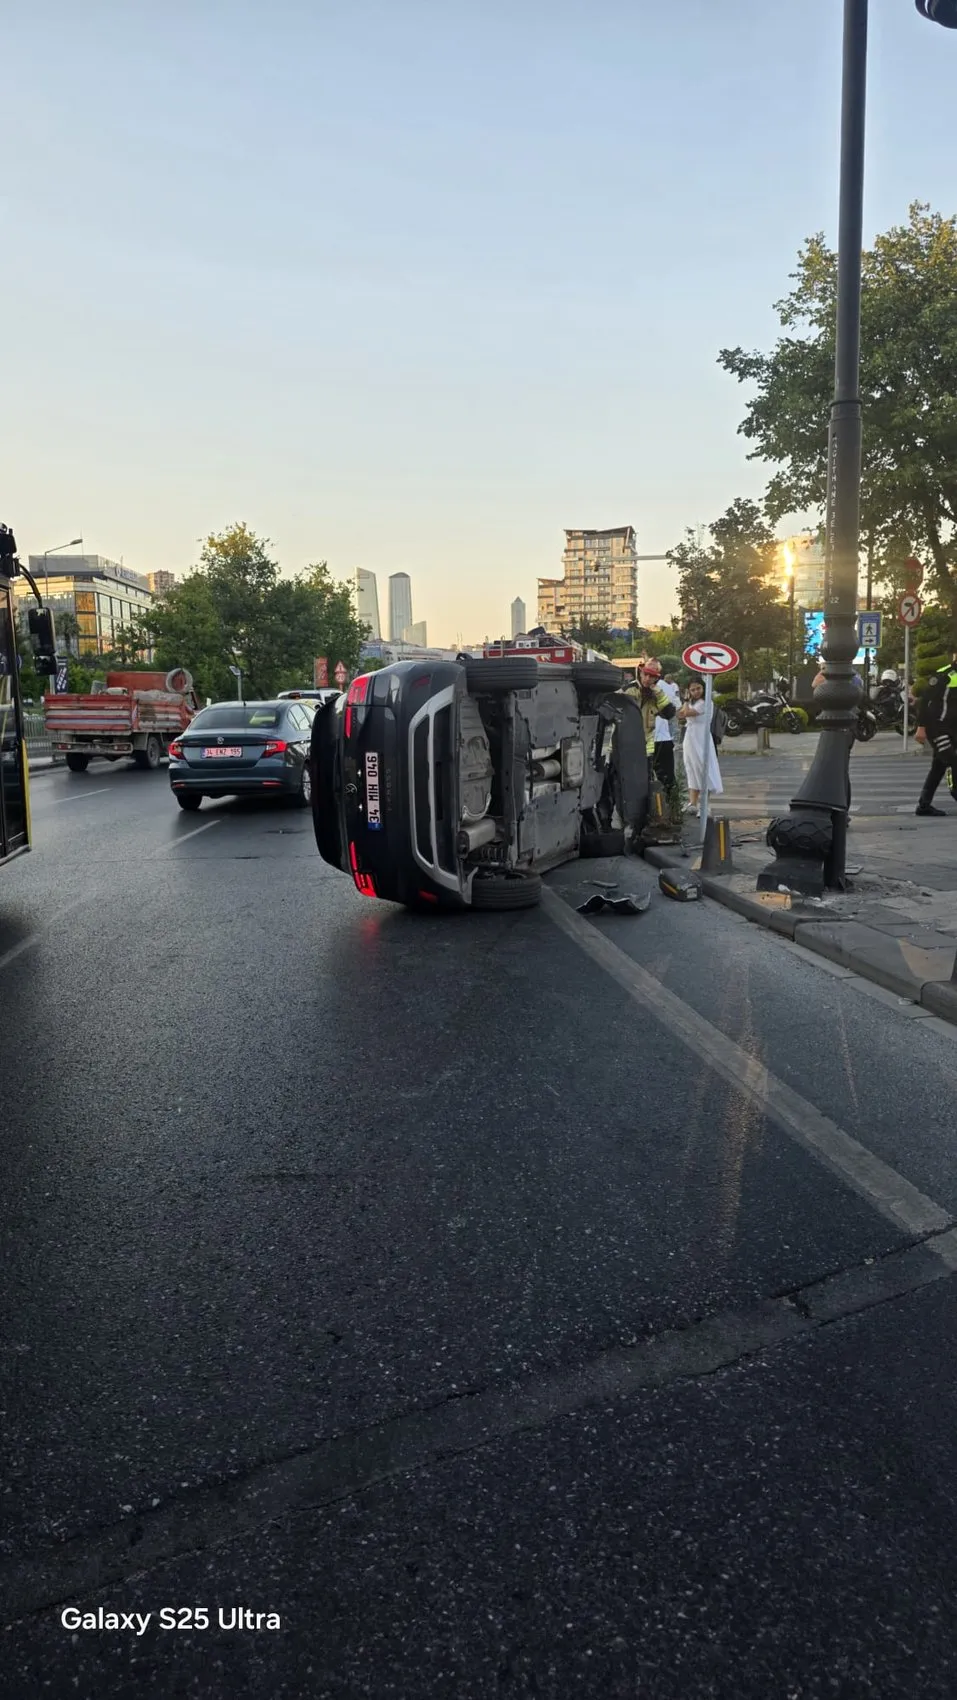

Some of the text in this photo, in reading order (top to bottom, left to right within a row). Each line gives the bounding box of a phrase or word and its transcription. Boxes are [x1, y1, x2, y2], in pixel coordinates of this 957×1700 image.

[366, 755, 380, 823] 34 MIH 046
